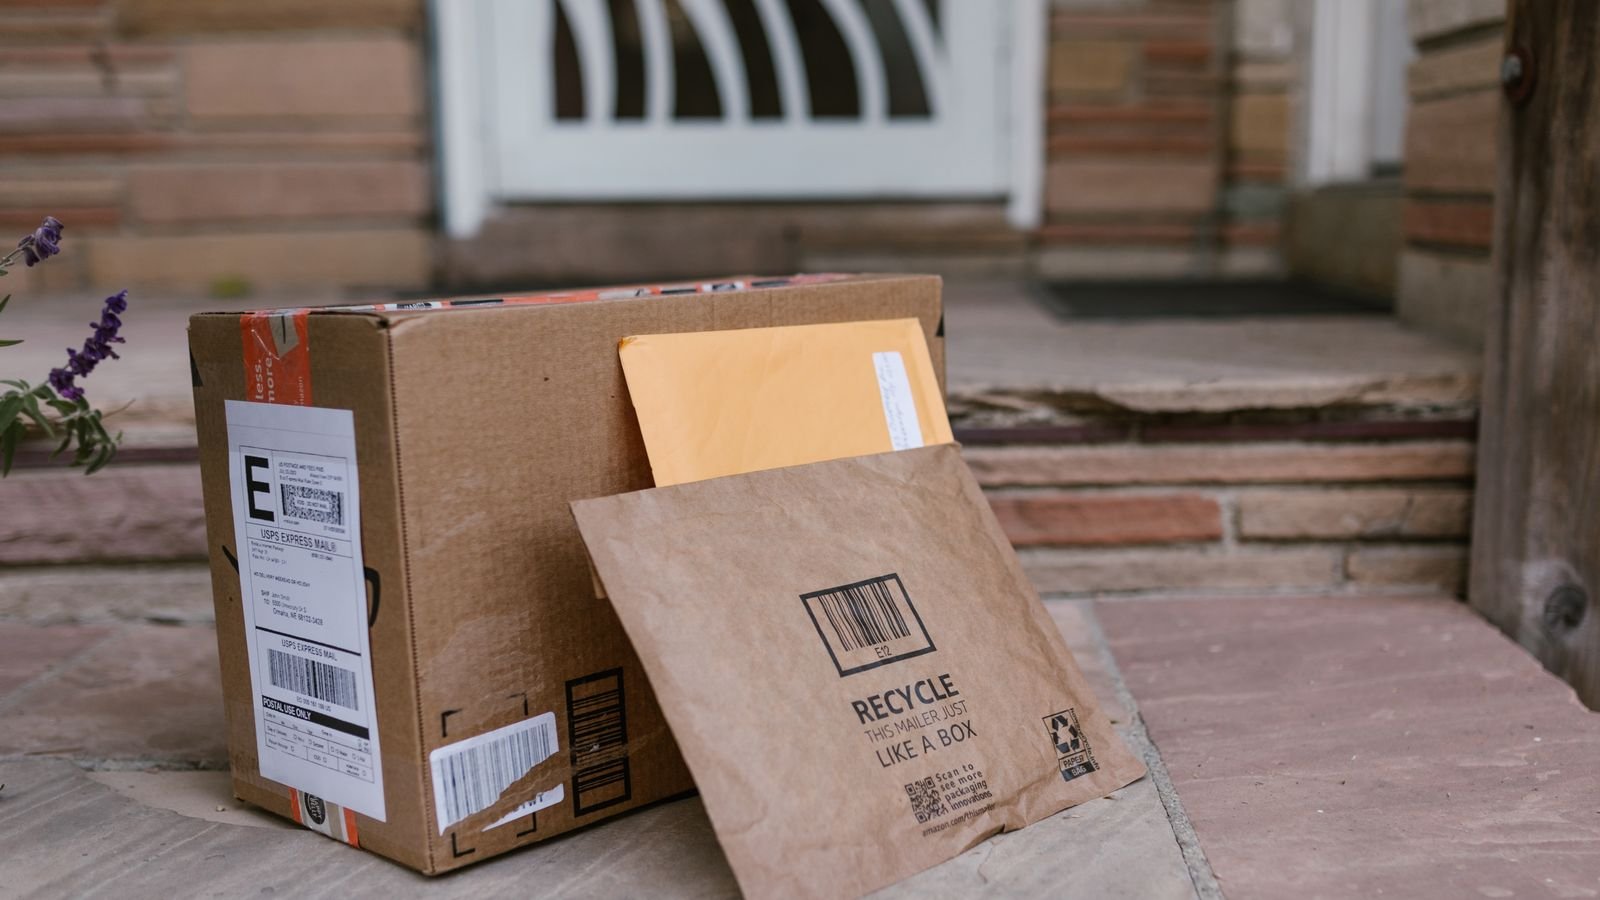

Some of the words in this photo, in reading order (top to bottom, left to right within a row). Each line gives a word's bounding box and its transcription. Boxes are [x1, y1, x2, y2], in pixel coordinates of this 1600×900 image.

[254, 359, 264, 400] less.
[245, 455, 275, 522] E
[261, 529, 279, 541] USPS
[281, 532, 312, 548] EXPRESS
[281, 640, 296, 650] USPS
[297, 643, 322, 657] EXPRESS
[323, 649, 338, 661] MAIL
[874, 645, 892, 659] E12
[263, 698, 284, 712] POSTAL
[283, 703, 296, 716] USE
[295, 707, 312, 720] ONLY
[851, 673, 960, 725] RECYCLE
[864, 724, 895, 743] THIS
[894, 709, 941, 735] MAILER
[939, 700, 968, 720] JUST
[876, 740, 918, 768] LIKE
[921, 735, 936, 754] A
[937, 720, 977, 747] BOX
[1063, 754, 1085, 768] PAPER
[1071, 765, 1087, 777] BAG
[935, 768, 960, 782] Scan
[962, 763, 974, 772] to
[940, 781, 956, 792] see
[958, 770, 983, 785] more
[944, 780, 988, 805] packaging
[950, 790, 993, 810] innovations
